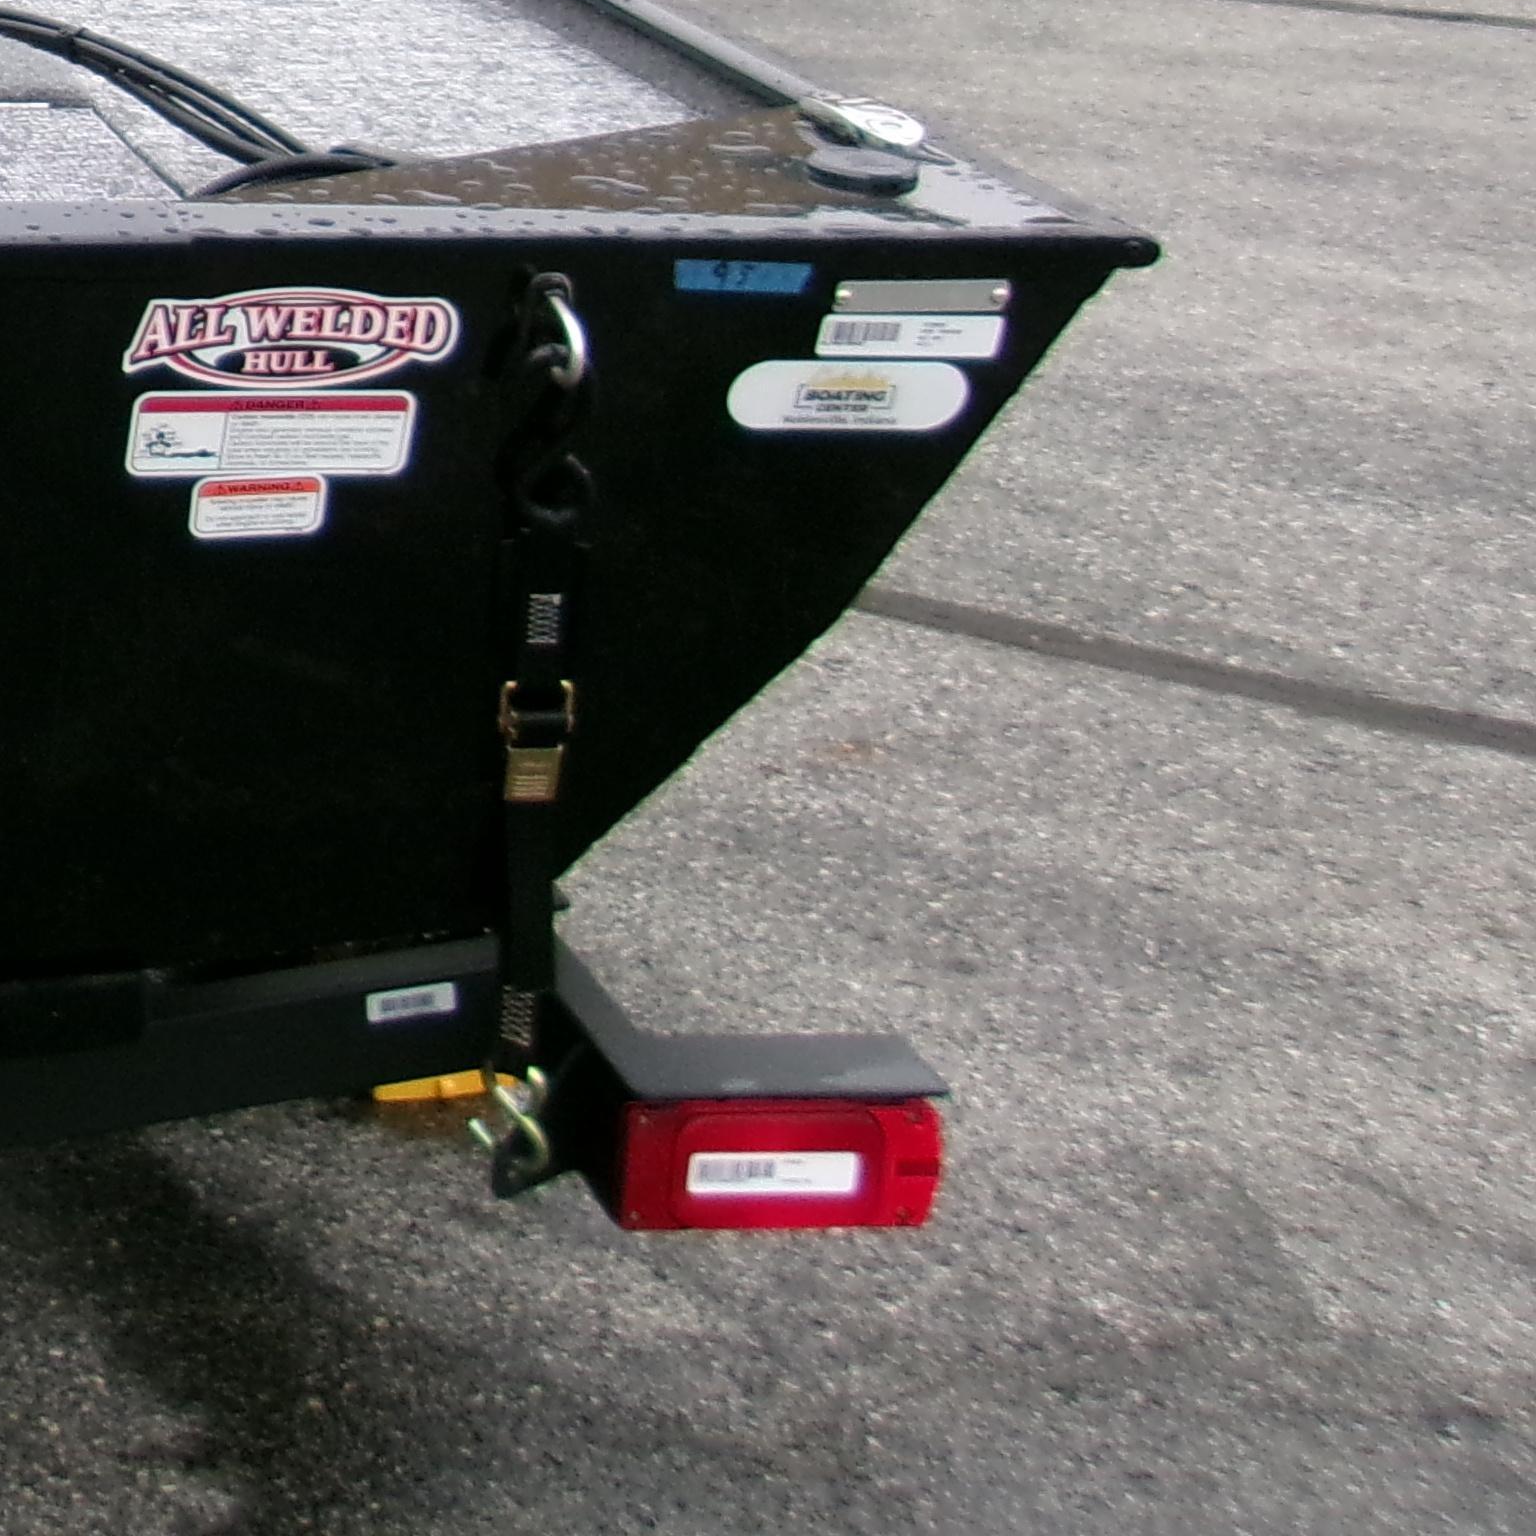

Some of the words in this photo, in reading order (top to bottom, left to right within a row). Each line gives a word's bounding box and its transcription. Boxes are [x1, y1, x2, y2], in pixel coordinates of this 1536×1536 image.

[131, 302, 236, 362] ALL
[242, 302, 450, 353] WELDED
[241, 349, 336, 373] HULL
[245, 399, 306, 411] DANGER
[226, 481, 291, 494] WARNING
